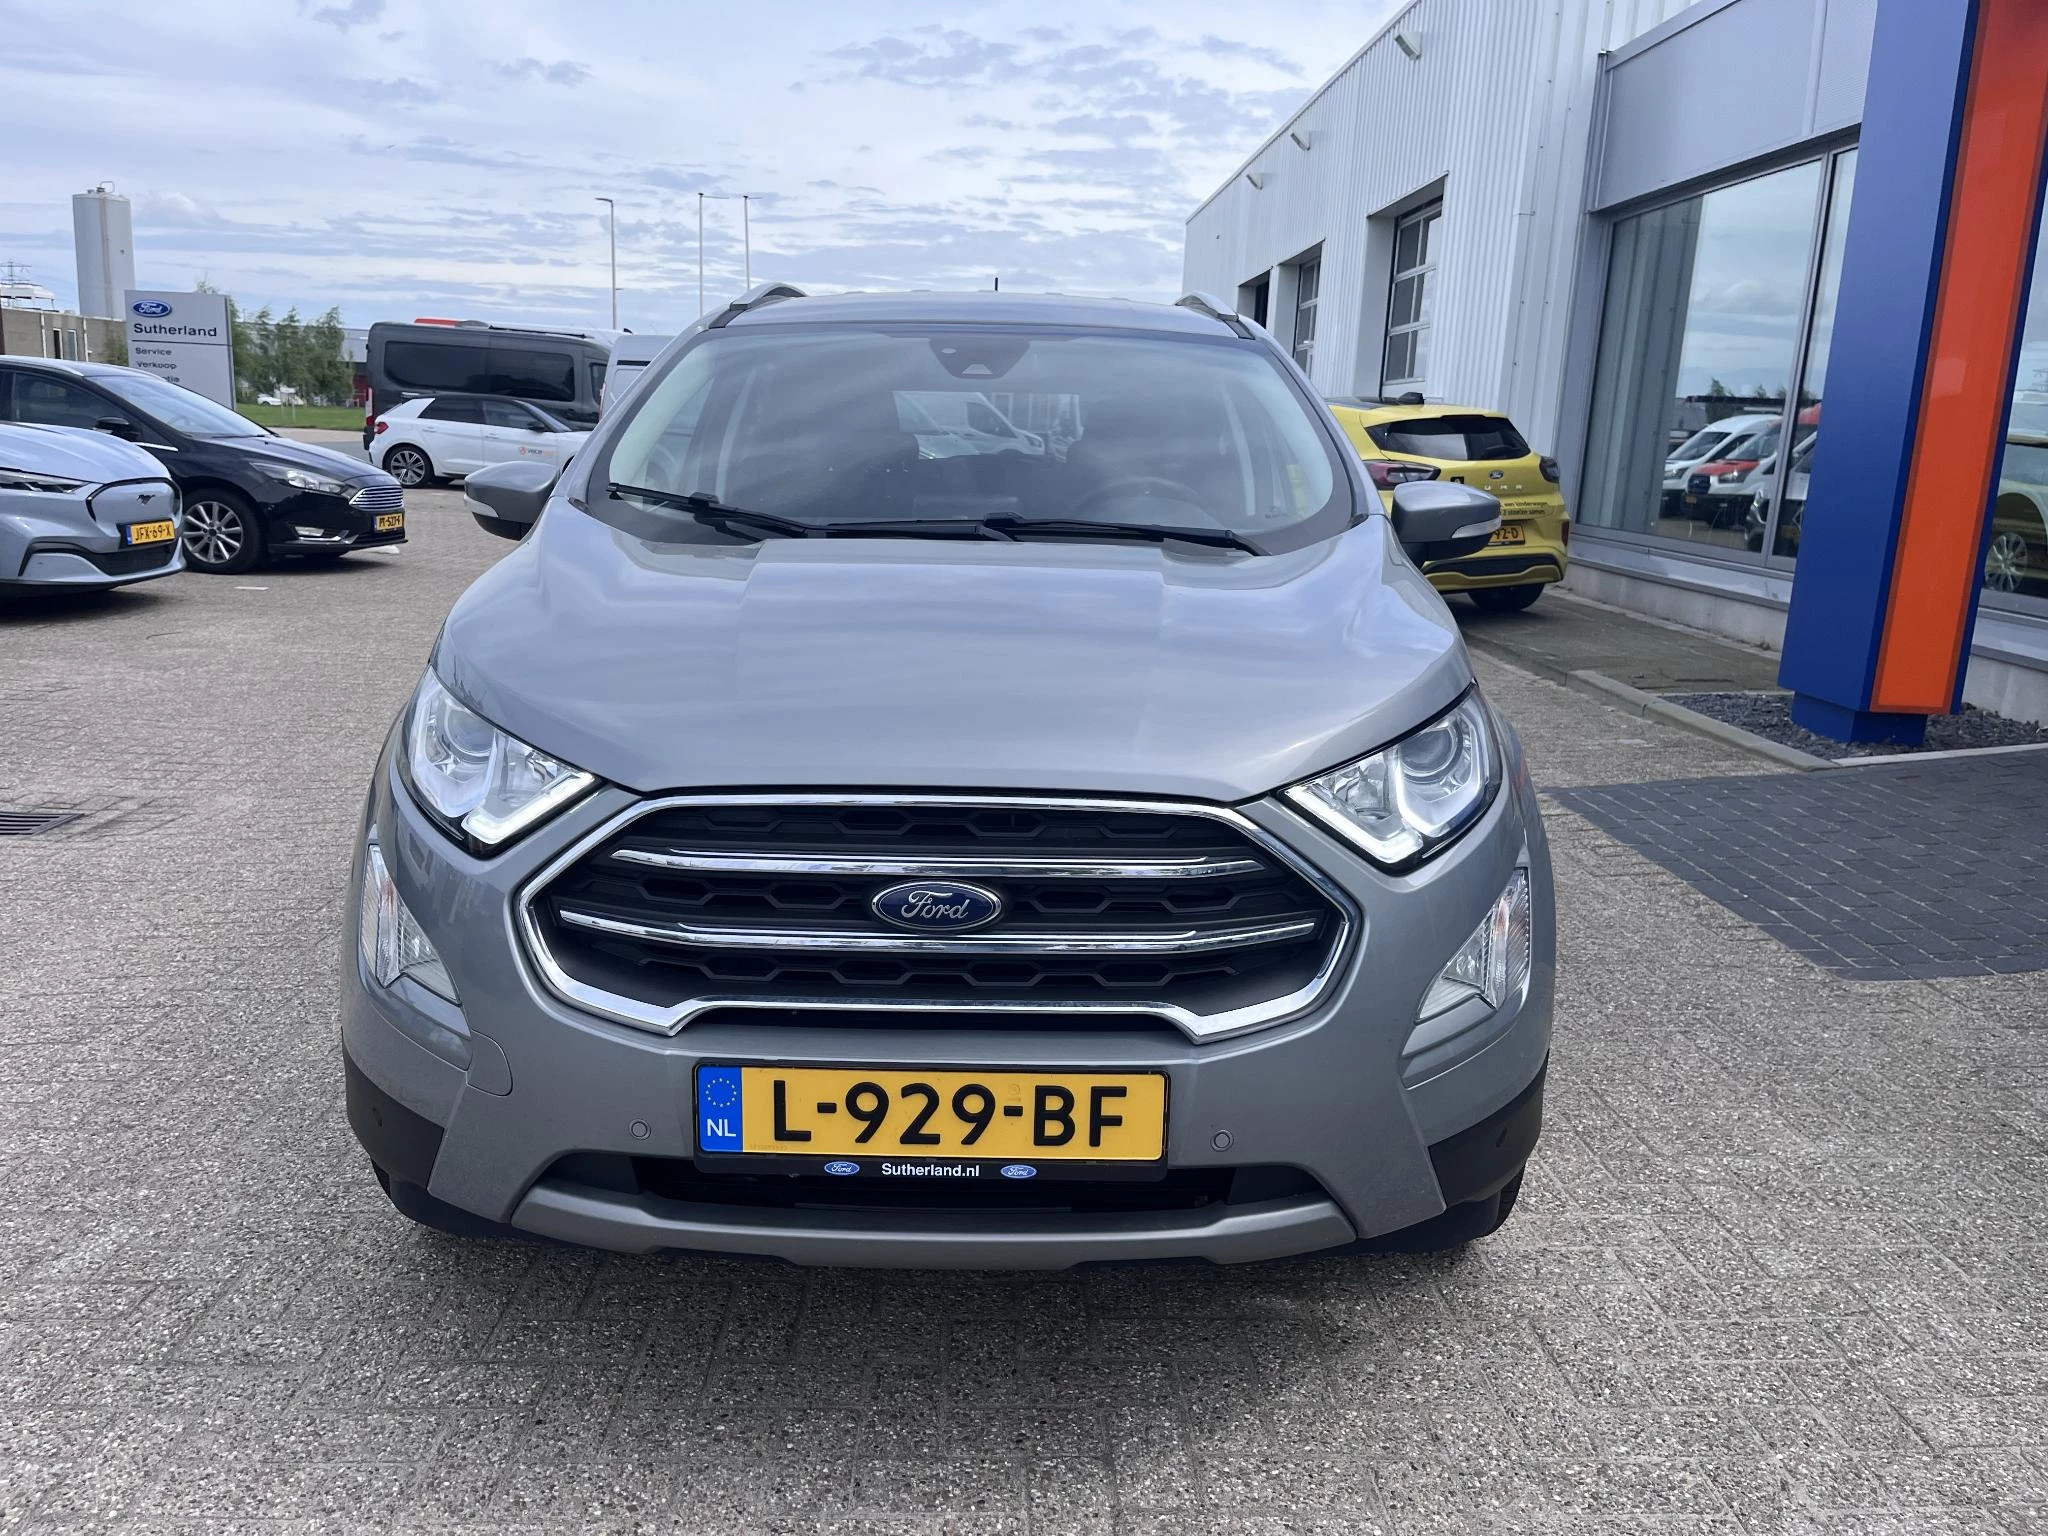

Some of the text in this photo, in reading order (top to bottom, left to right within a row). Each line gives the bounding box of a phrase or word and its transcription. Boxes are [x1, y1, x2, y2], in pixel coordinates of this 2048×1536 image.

[133, 323, 217, 337] Sutherland
[135, 347, 172, 356] Service
[136, 361, 177, 370] Verkoop
[901, 890, 970, 919] Ford
[773, 1079, 1127, 1147] L-929-BF
[706, 1118, 737, 1137] NL
[881, 1163, 980, 1177] Sutherland.nl
